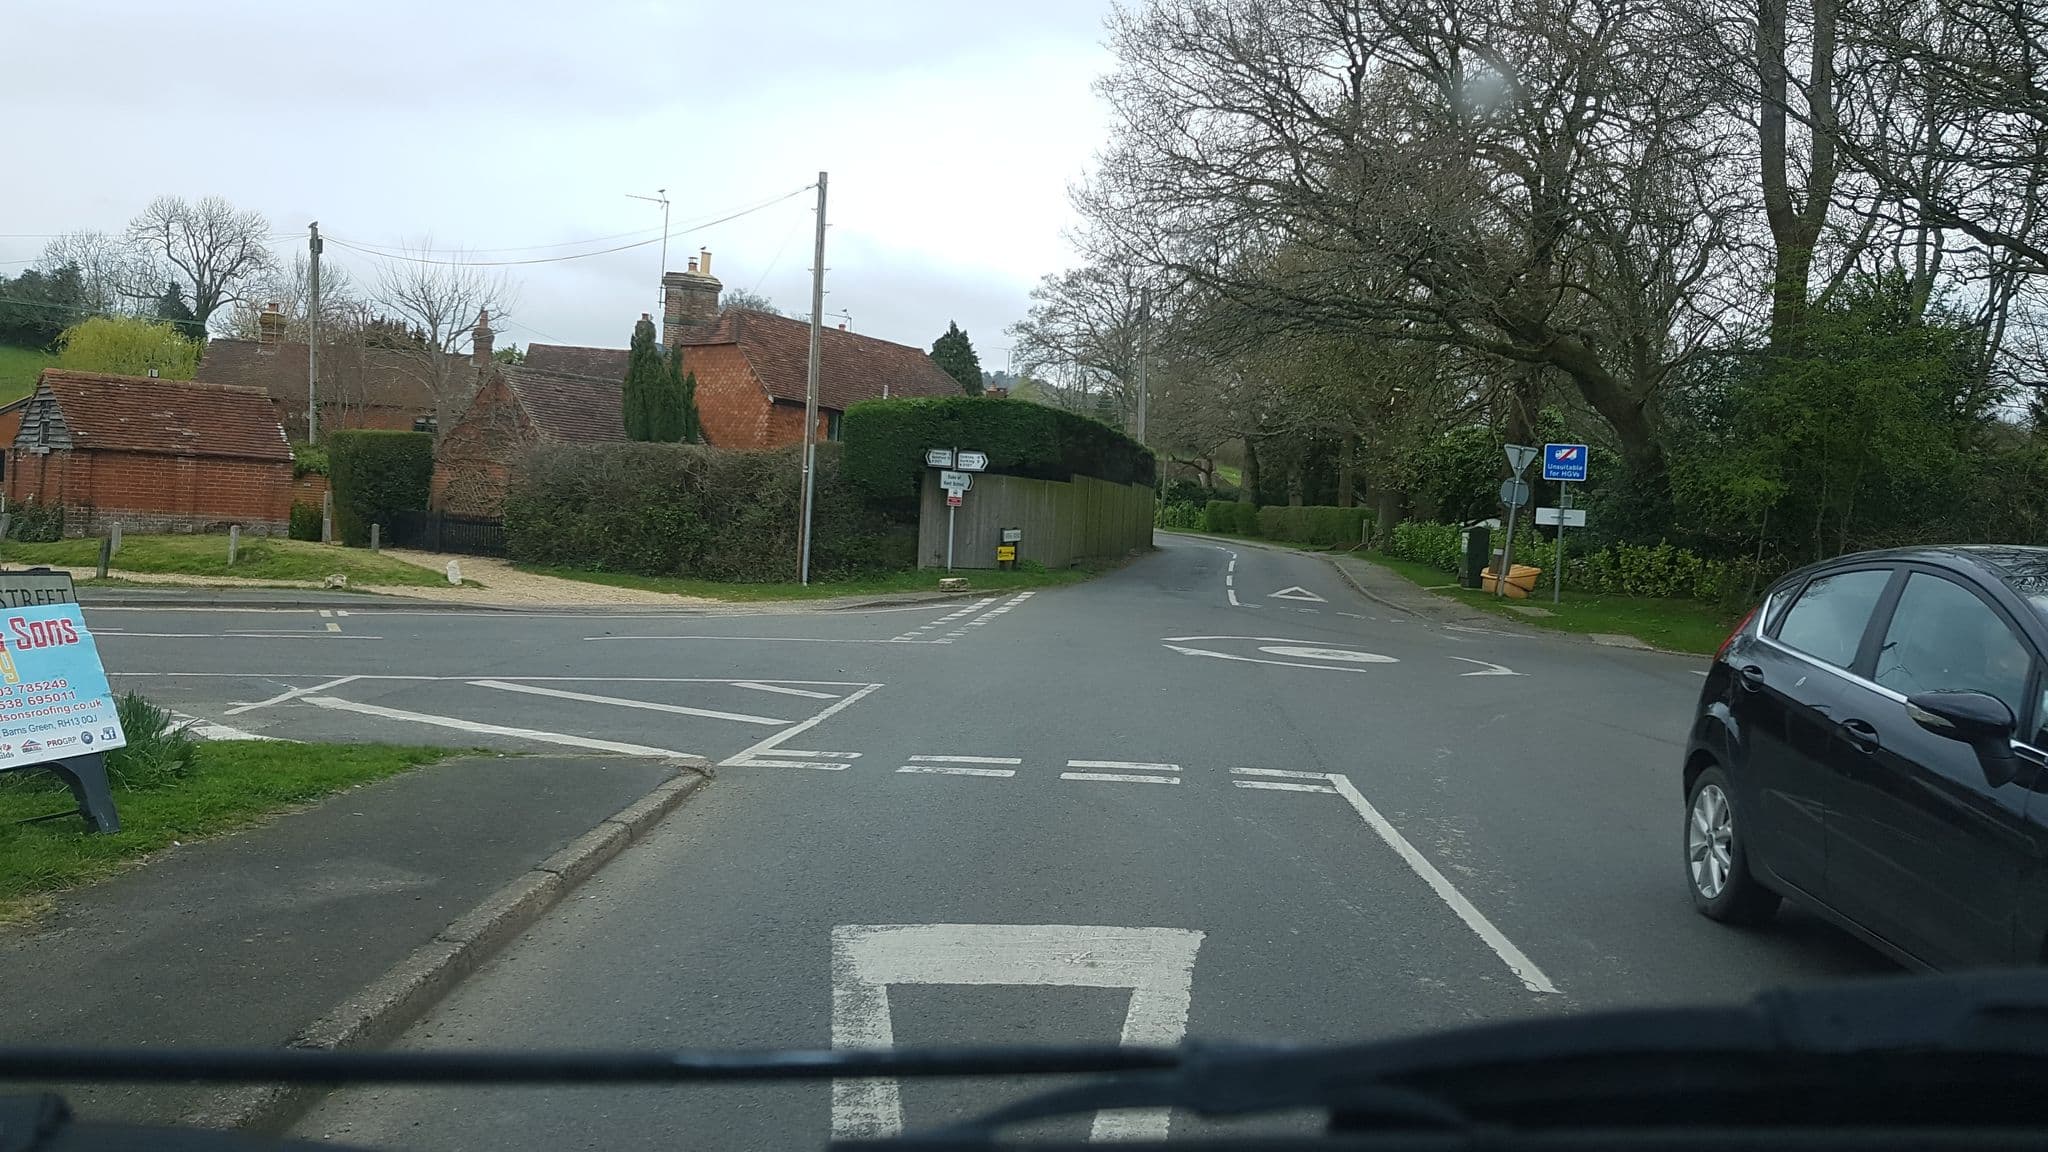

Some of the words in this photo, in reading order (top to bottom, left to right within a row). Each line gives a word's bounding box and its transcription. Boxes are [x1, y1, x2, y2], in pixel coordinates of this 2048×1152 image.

[1547, 463, 1583, 471] Unsuitable
[9, 616, 78, 650] Sons
[17, 680, 68, 694] 785249
[28, 691, 76, 706] 695011
[57, 717, 80, 728] RH13
